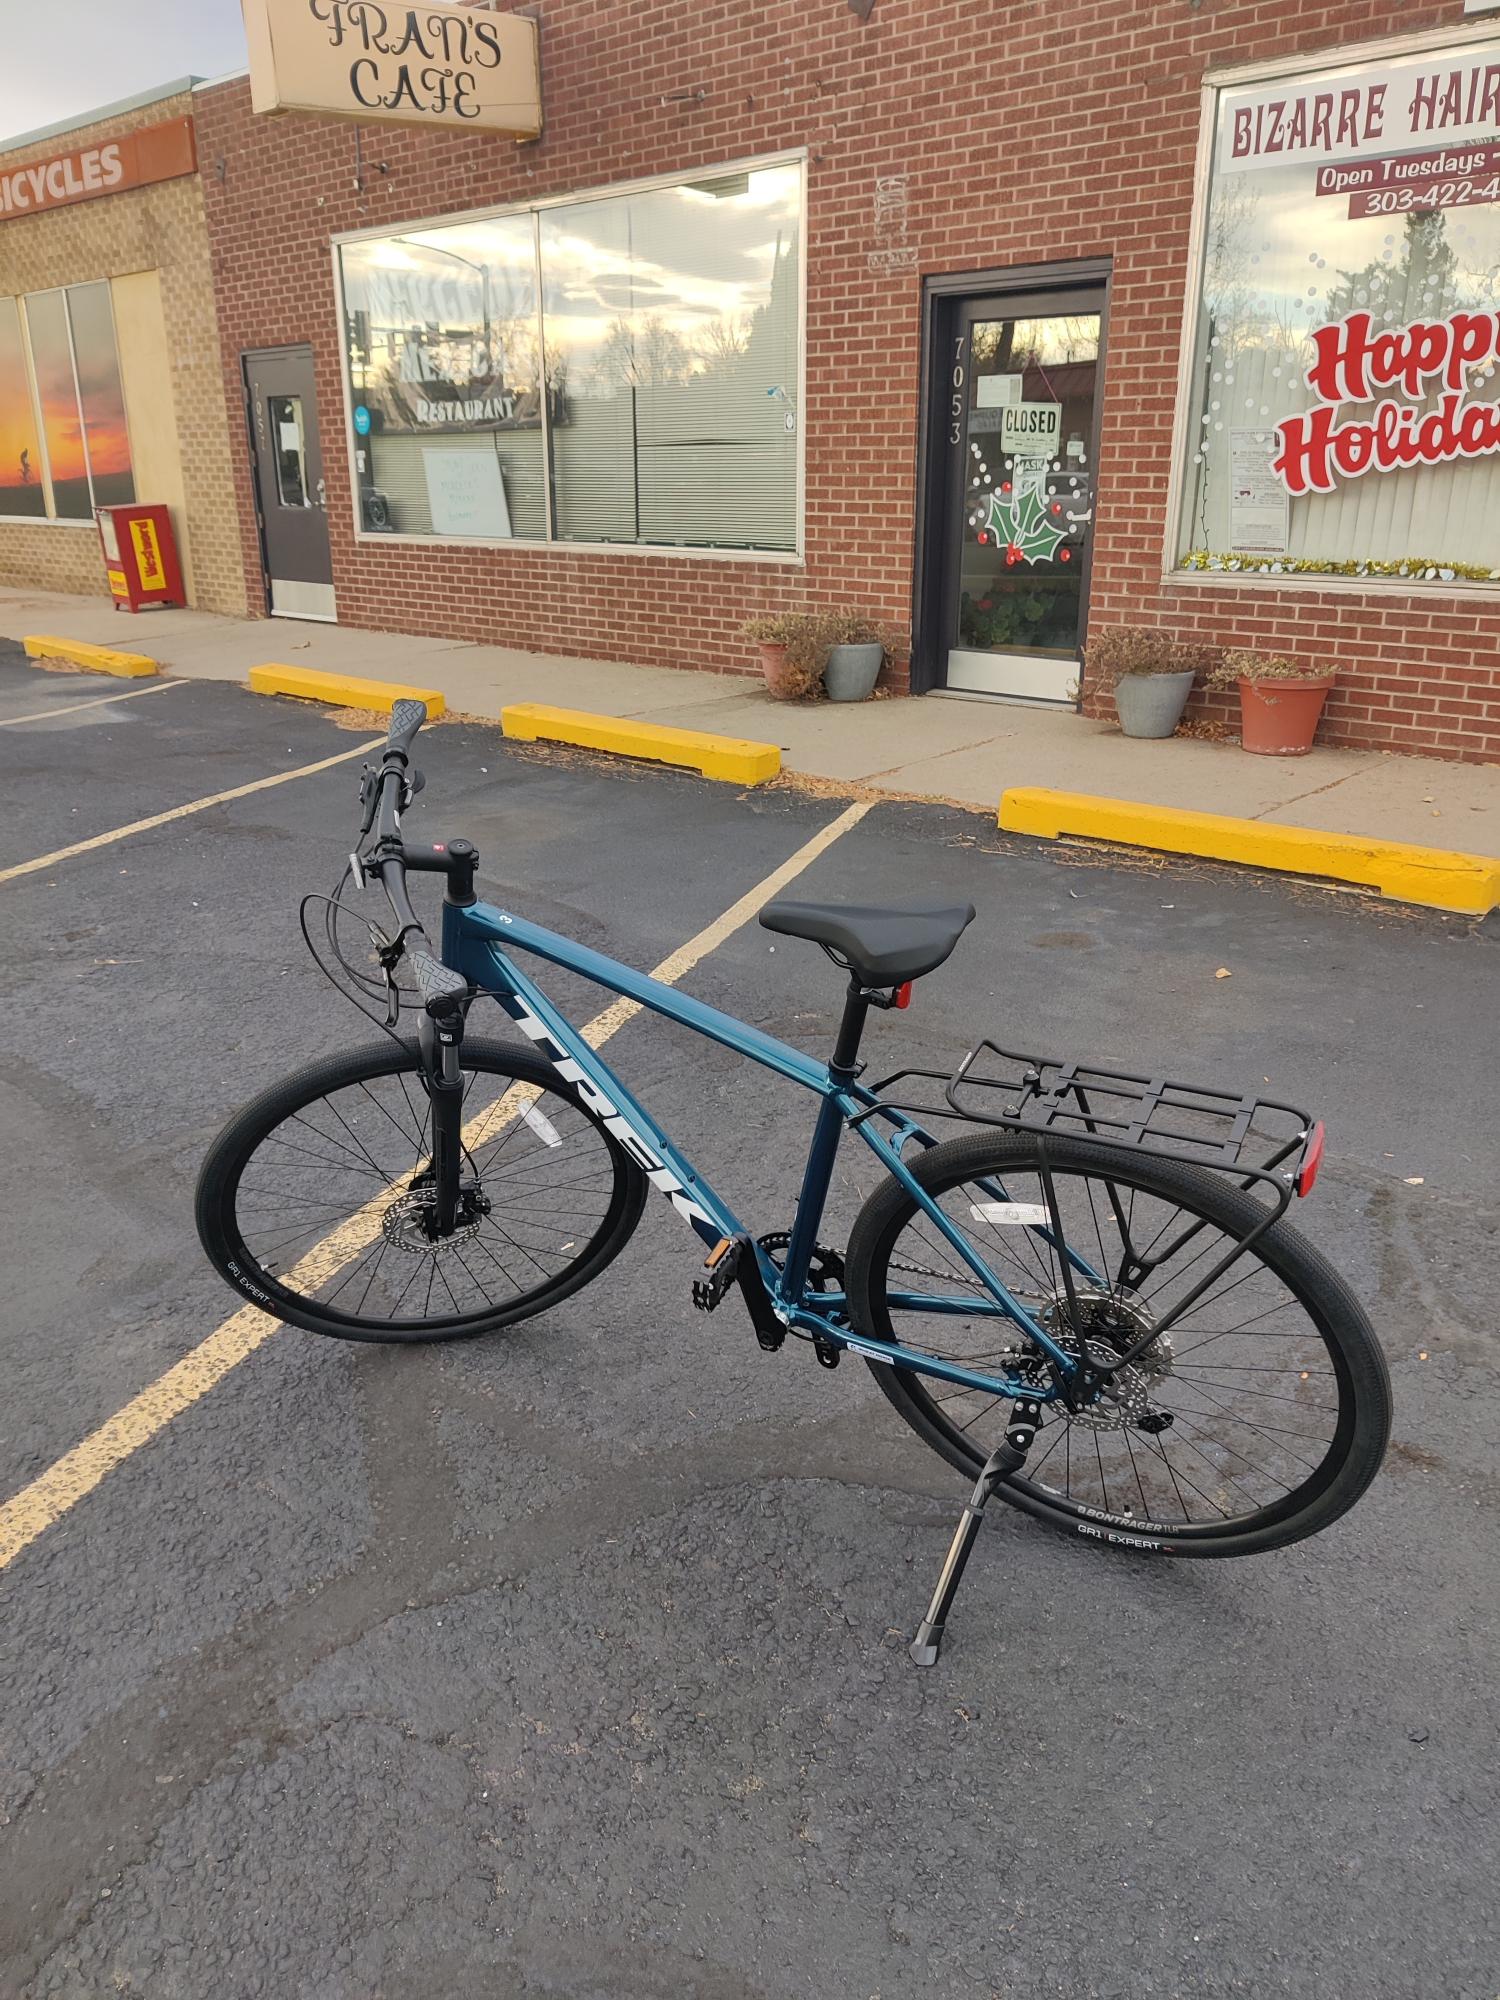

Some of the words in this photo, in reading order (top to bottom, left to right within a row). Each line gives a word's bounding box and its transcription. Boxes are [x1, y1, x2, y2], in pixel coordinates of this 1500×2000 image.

[309, 0, 501, 68] FRAN'S
[350, 58, 481, 119] CAFE
[1232, 83, 1388, 158] BIZARRE
[1408, 63, 1500, 132] HAIR
[0, 143, 122, 212] ICYCLES
[1321, 167, 1373, 191] Open
[1381, 151, 1486, 180] Tuesdays
[1307, 311, 1500, 400] Happ
[416, 396, 513, 422] RESTAURANT
[1006, 409, 1056, 433] CLOSED
[1273, 394, 1500, 492] Holida
[513, 994, 717, 1227] TREK
[227, 1261, 241, 1277] GR1
[239, 1276, 270, 1303] EXPERT
[1077, 1524, 1102, 1538] GR1
[1108, 1533, 1160, 1550] EXPERT
[1086, 1508, 1163, 1532] BONTRAGER
